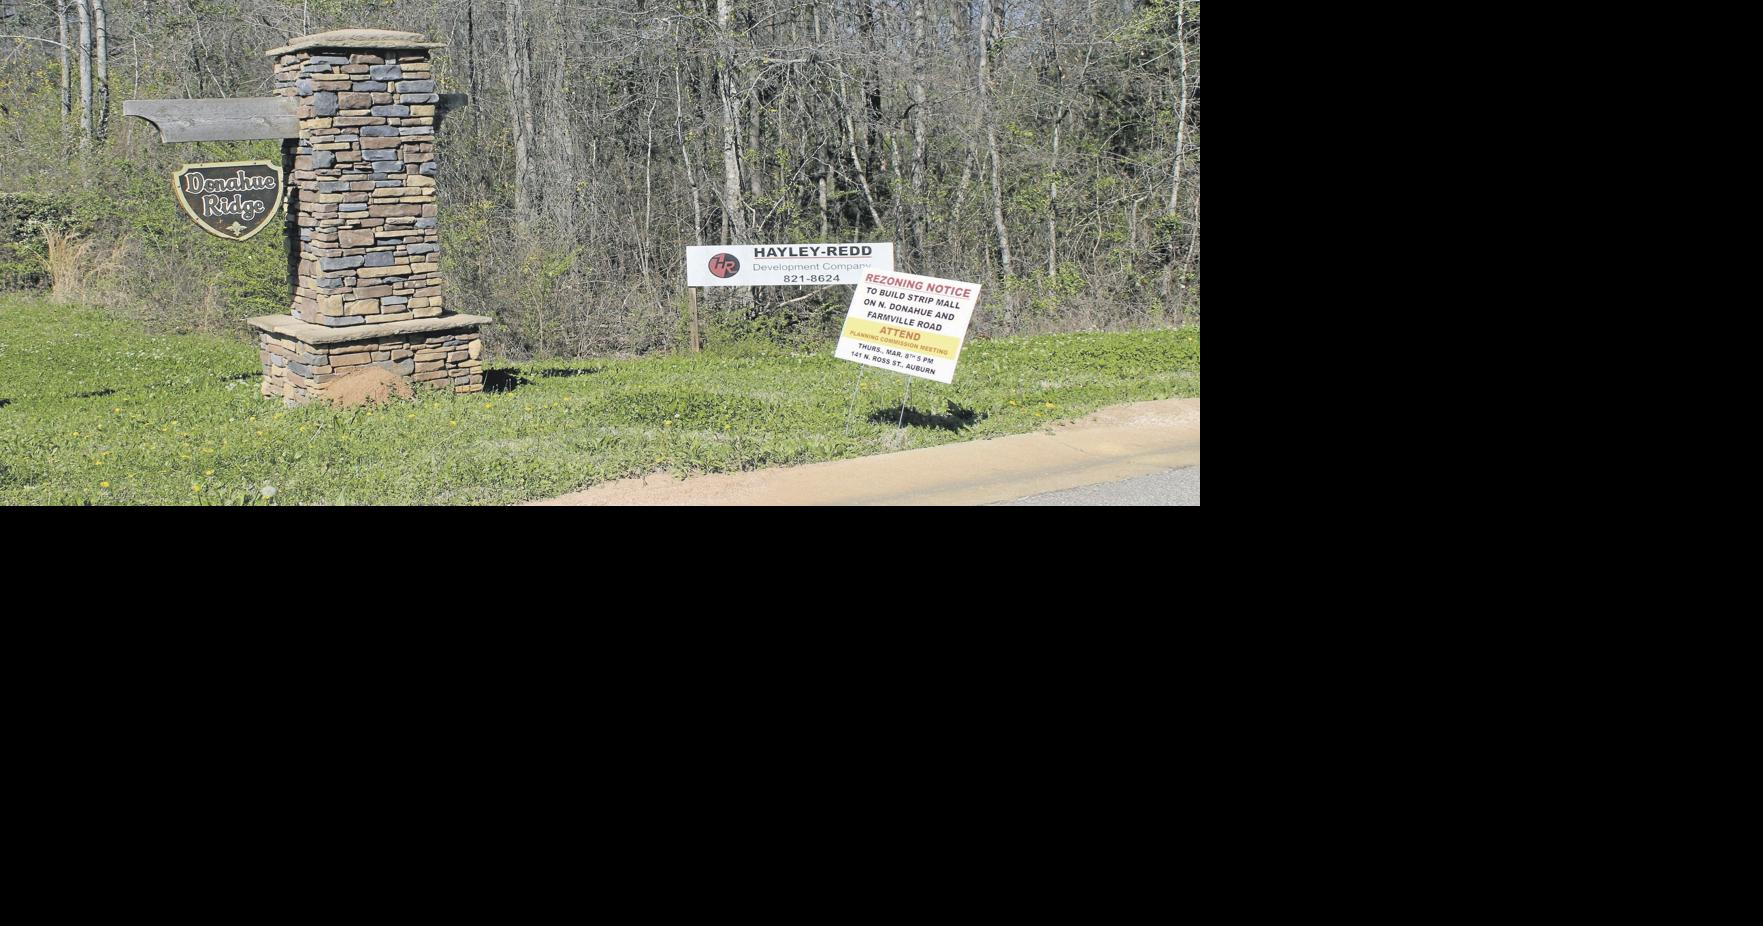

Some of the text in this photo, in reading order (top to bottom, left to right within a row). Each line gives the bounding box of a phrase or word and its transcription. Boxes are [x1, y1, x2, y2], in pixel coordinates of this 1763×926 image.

[184, 170, 276, 194] Donahue
[201, 194, 265, 221] Ridge
[754, 245, 872, 257] HAYLEY-REDD
[753, 263, 819, 272] Development
[783, 274, 840, 283] 821-8624
[865, 273, 972, 298] REZONING NOTICE
[866, 287, 960, 309] TO BUILD STRIP MALL
[863, 298, 955, 321] ON N. DONAHUE AND
[867, 311, 942, 331] FARMVILLE ROAD
[849, 330, 949, 355] PLANNING COMMISSION MEETING
[879, 326, 921, 341] ATTEND
[886, 348, 902, 358] MAR.
[872, 355, 891, 365] ROSS
[905, 363, 936, 375] AUBURN
